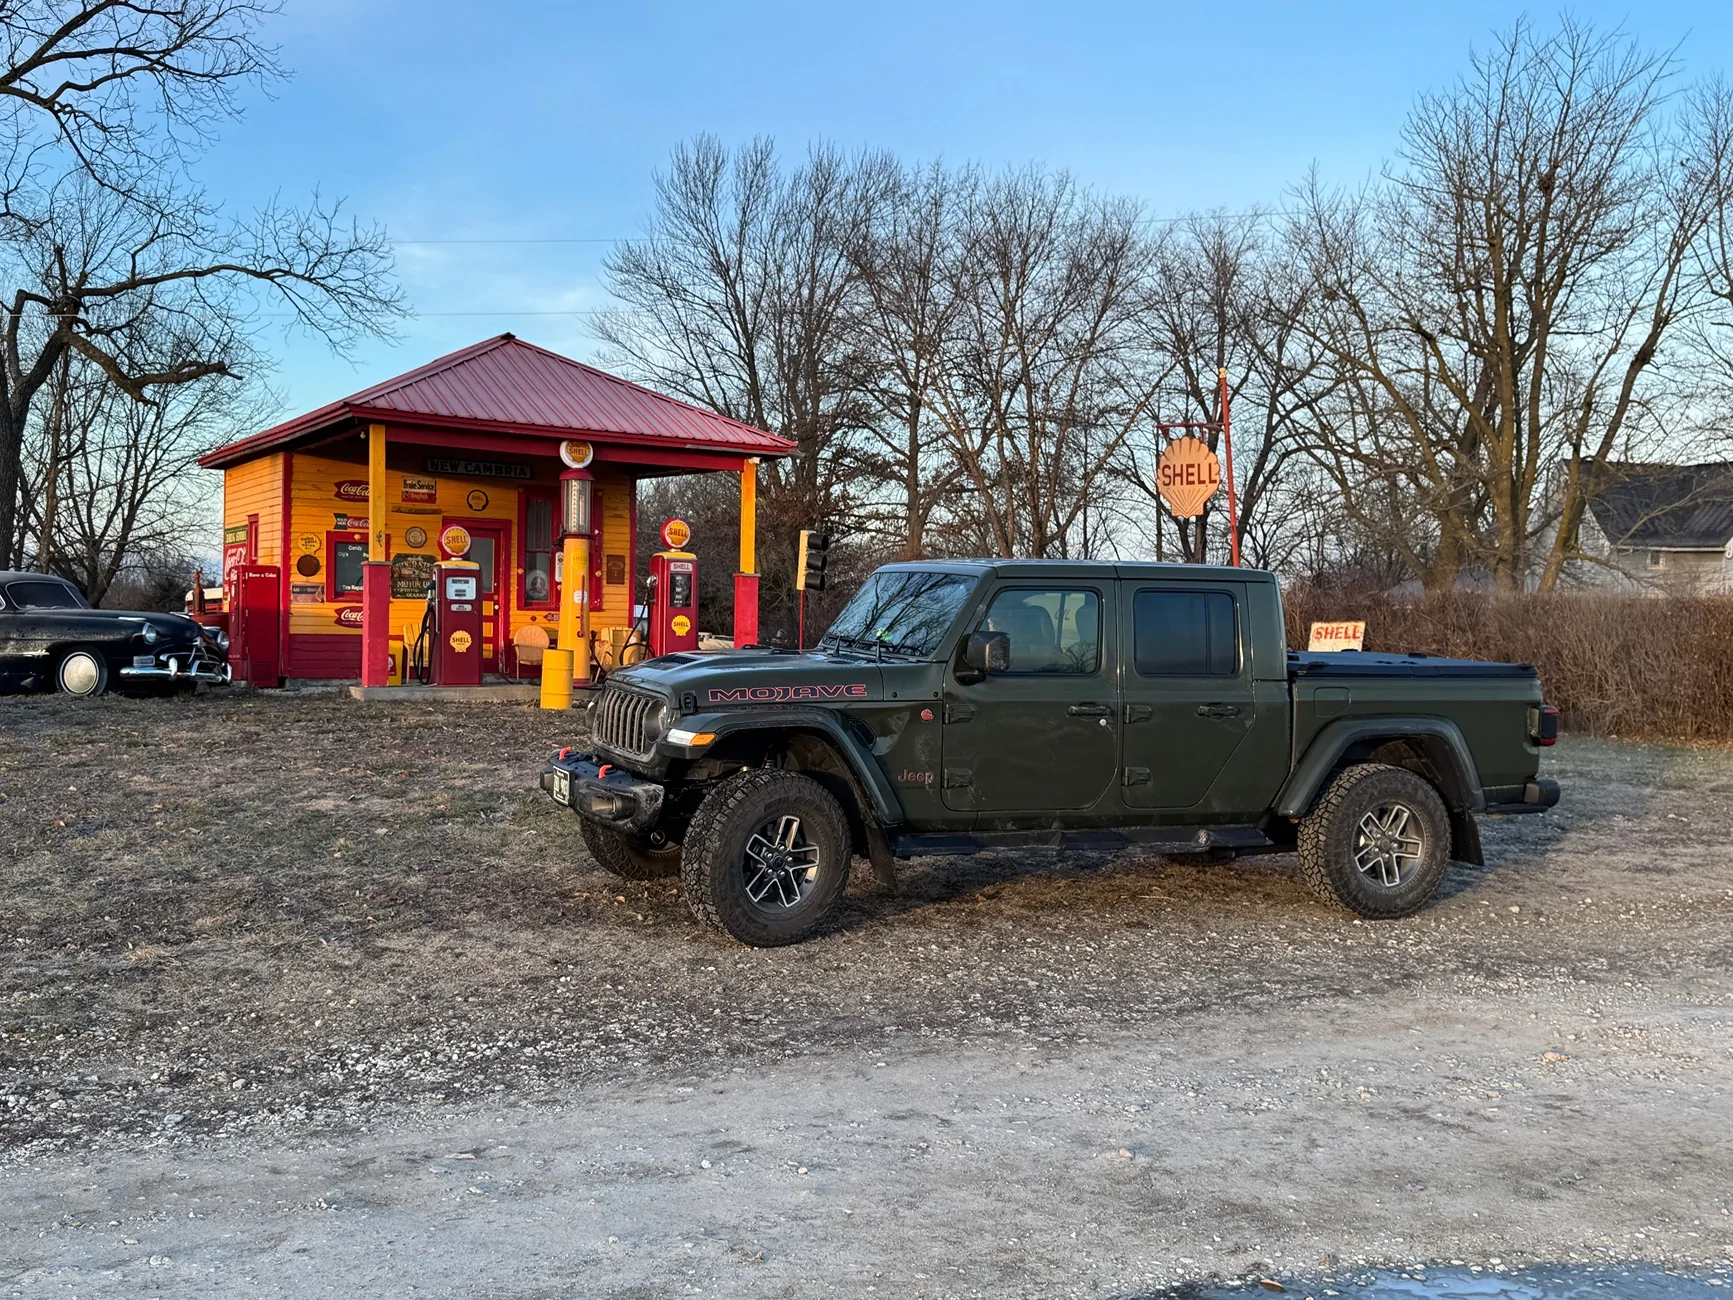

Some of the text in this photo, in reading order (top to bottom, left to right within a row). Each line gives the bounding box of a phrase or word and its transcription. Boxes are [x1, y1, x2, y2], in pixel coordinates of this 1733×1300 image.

[569, 447, 587, 455] SHELL
[429, 460, 527, 477] NEW CAMBRIA
[1161, 463, 1217, 487] SHELL
[403, 479, 435, 491] Brake Service
[446, 535, 468, 545] SHELL
[668, 528, 687, 538] SHELL
[1314, 626, 1361, 640] SHELL
[708, 684, 868, 702] MOJAVE
[897, 769, 934, 784] Jeep
